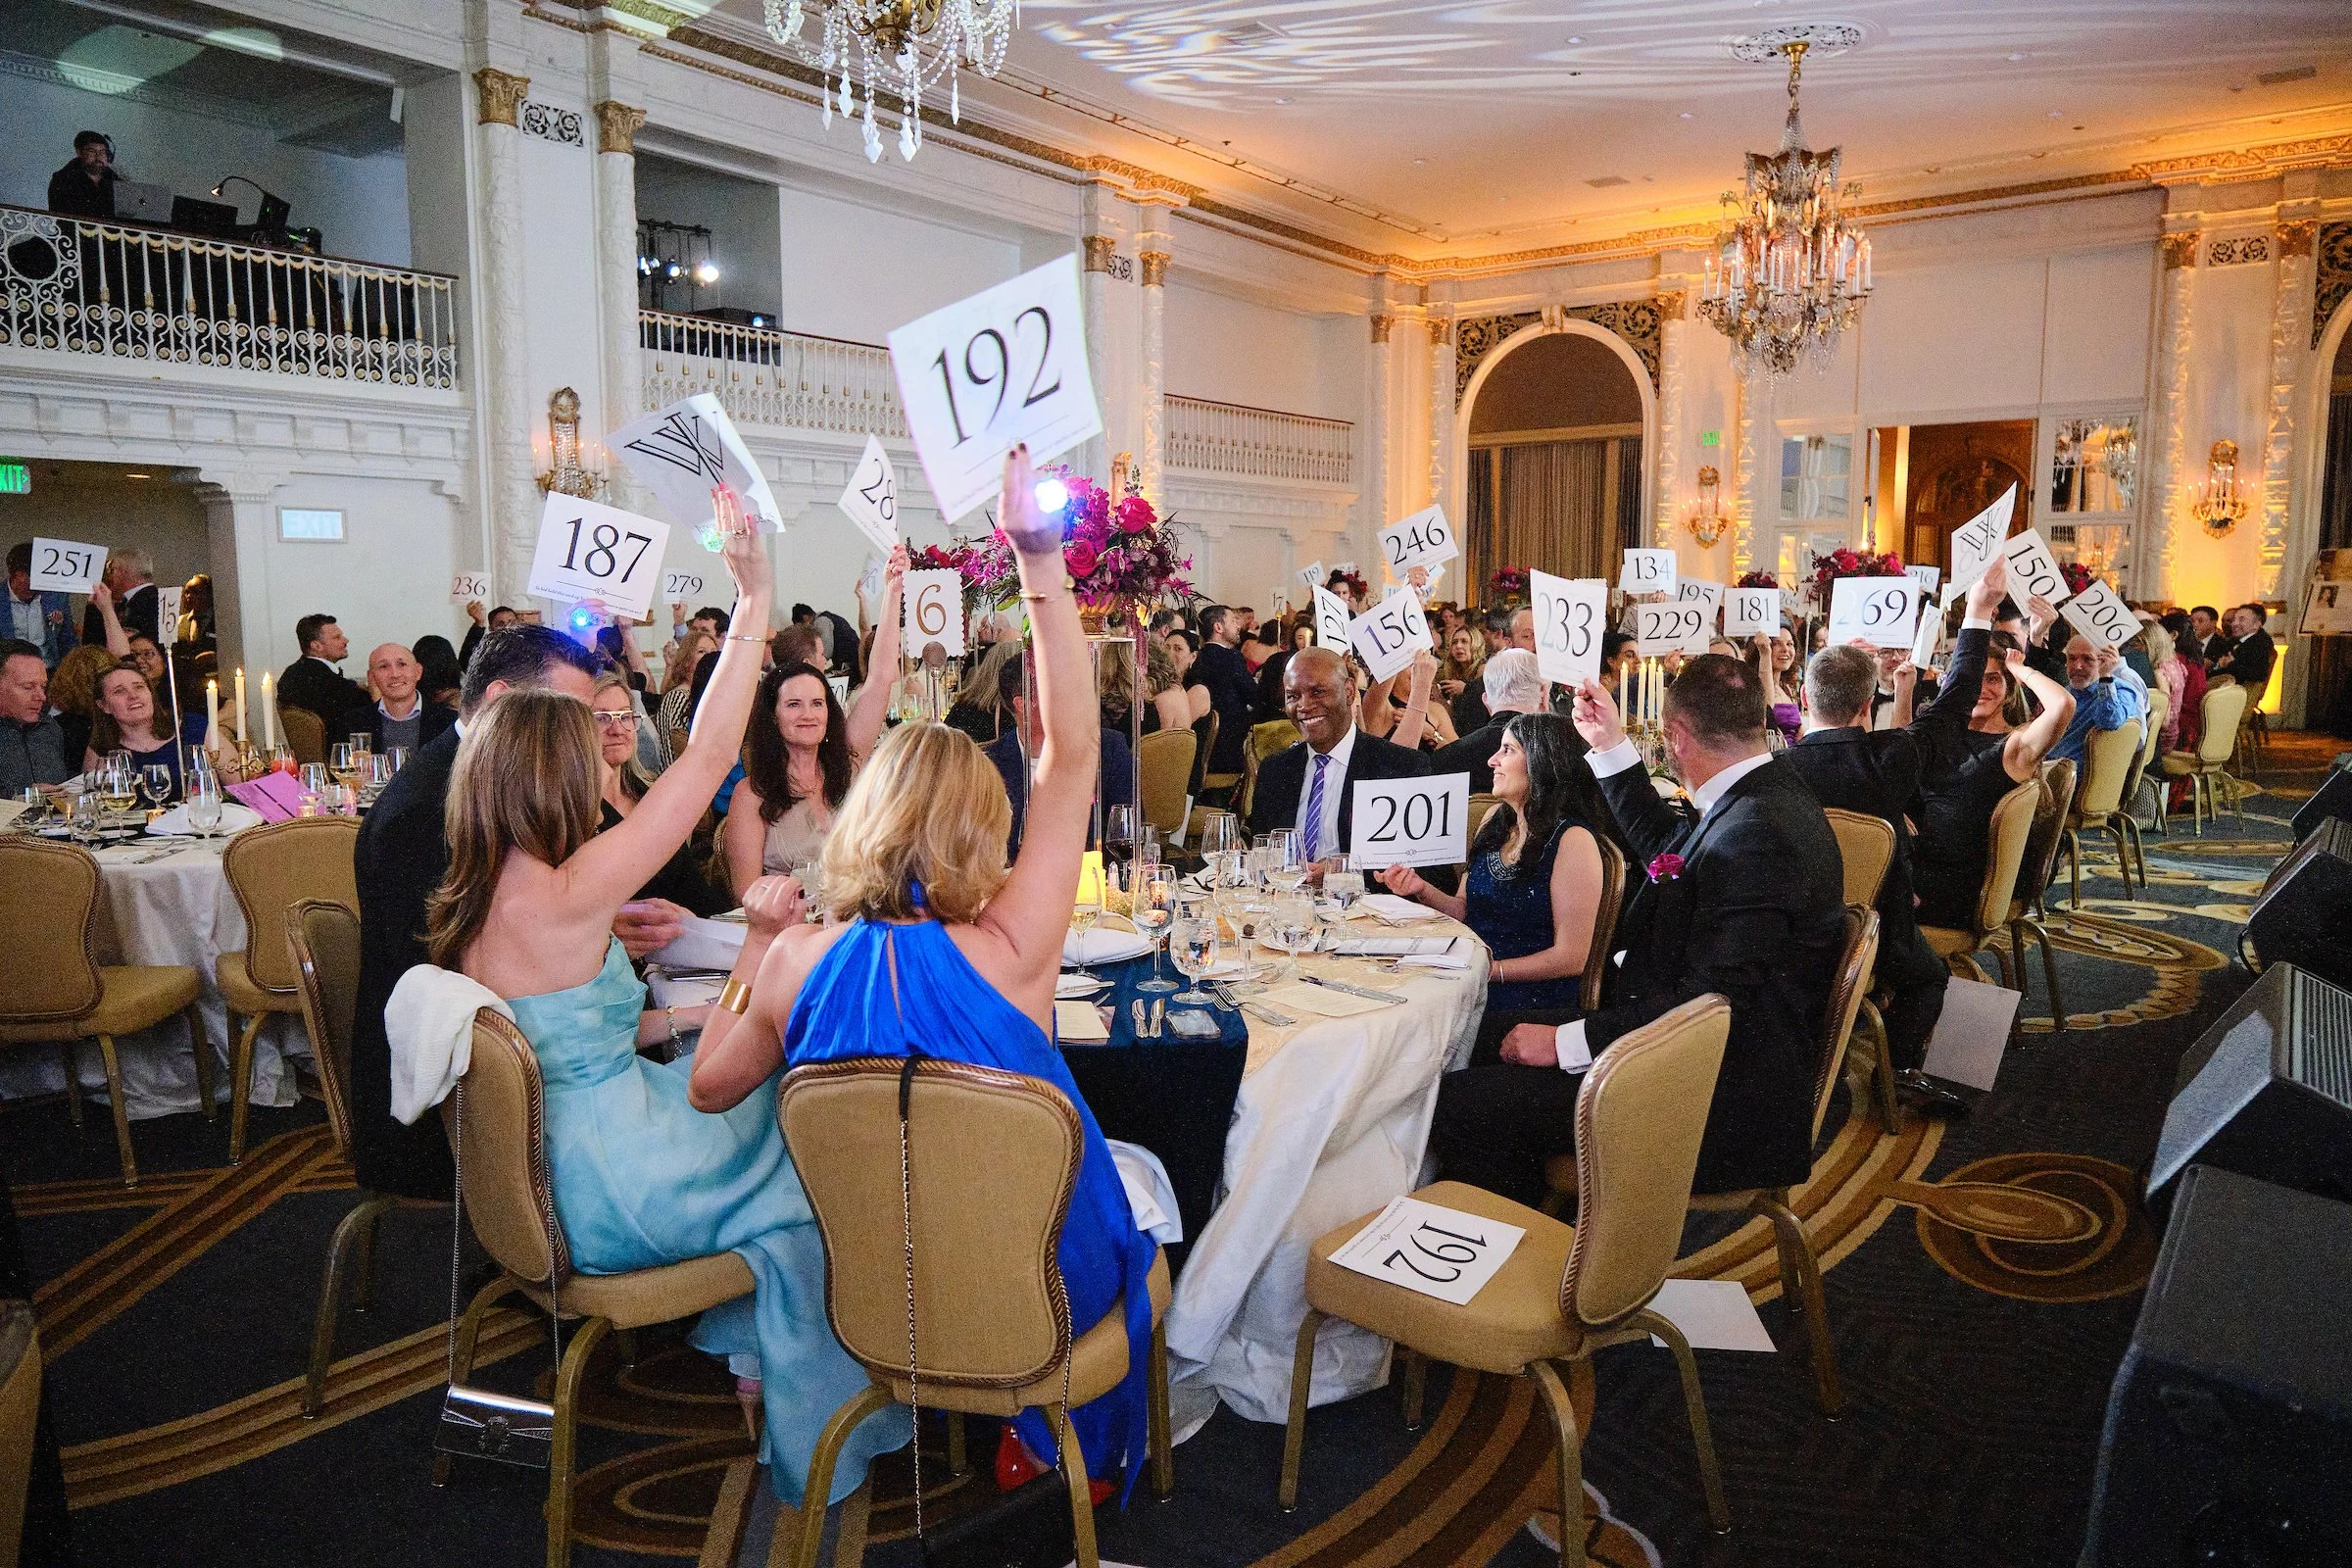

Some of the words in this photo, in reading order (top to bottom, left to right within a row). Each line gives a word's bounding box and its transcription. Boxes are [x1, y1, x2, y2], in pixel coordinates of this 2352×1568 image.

[930, 306, 1061, 449] 192
[41, 548, 92, 578] 251
[558, 517, 653, 584] 187
[1386, 515, 1446, 565] 246
[452, 576, 486, 596] 236
[666, 574, 703, 595] 279
[1634, 556, 1671, 580] 134
[2008, 543, 2056, 599] 150
[160, 593, 176, 634] 15
[916, 584, 947, 636] 6
[1321, 595, 1348, 646] 127
[1363, 599, 1421, 659] 156
[1538, 592, 1592, 658] 233
[1644, 610, 1702, 640] 229
[1738, 596, 1771, 622] 181
[2076, 589, 2132, 642] 206
[1366, 790, 1451, 842] 201
[1382, 1219, 1488, 1283] 192
